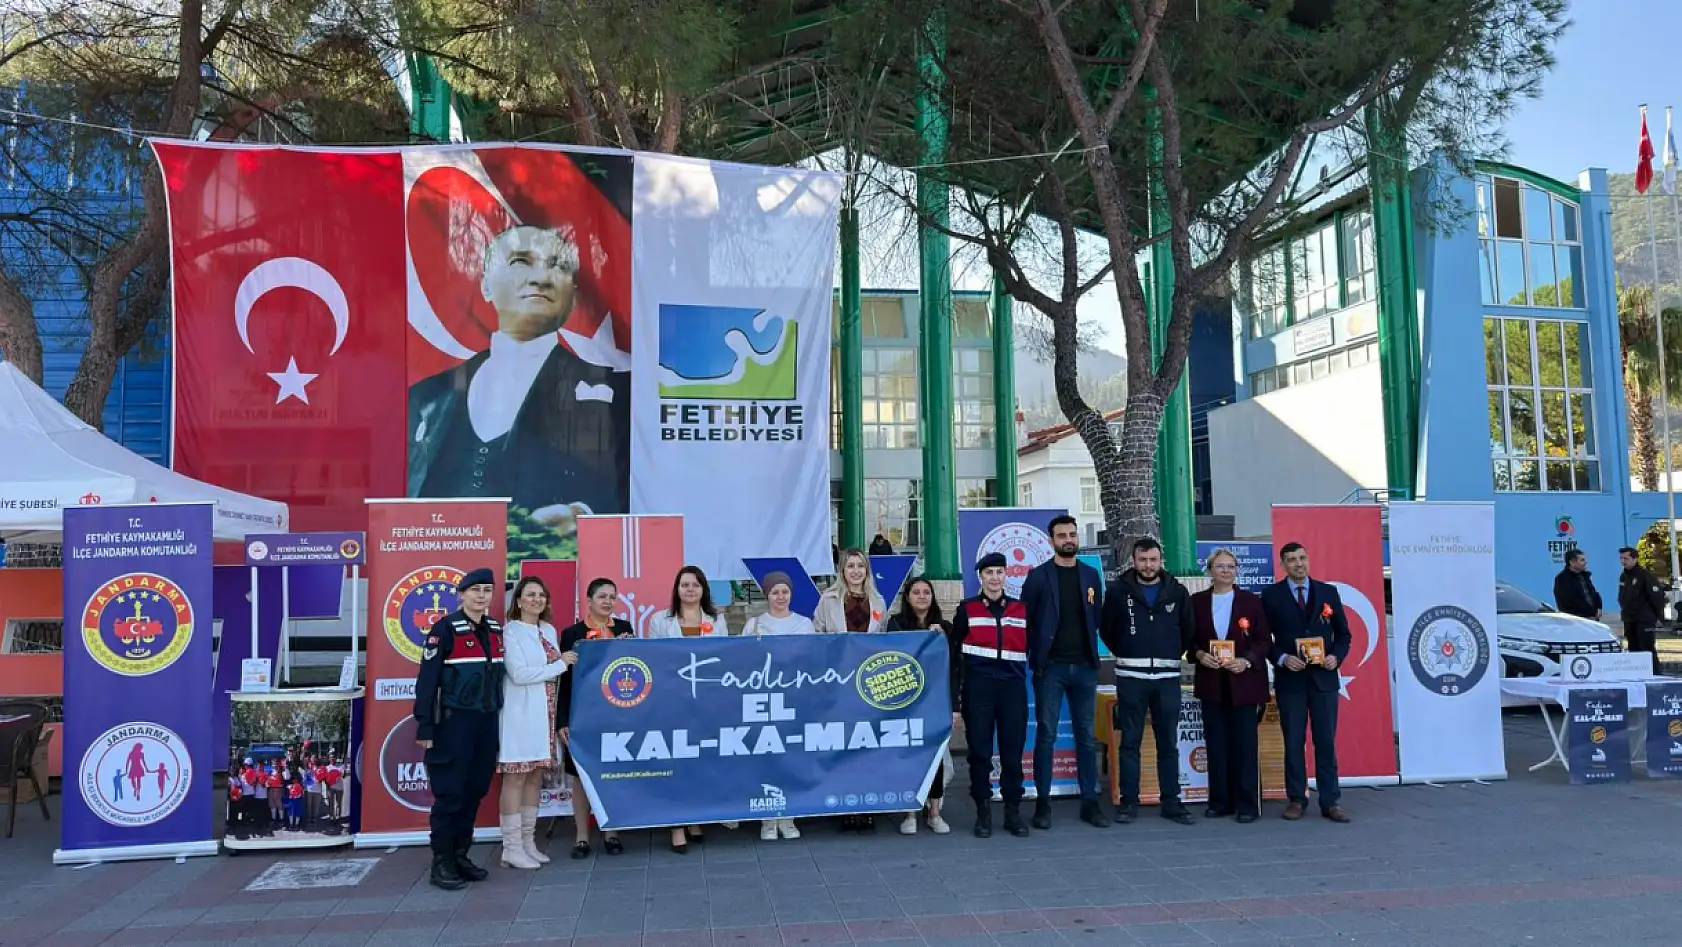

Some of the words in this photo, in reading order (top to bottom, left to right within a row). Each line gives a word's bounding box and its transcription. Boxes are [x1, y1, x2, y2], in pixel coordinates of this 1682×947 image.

[660, 402, 803, 425] FETHİYE
[661, 425, 803, 441] BELEDİYESİ
[19, 496, 58, 511] ŞUBESİ
[128, 518, 143, 528] T.C.
[431, 513, 446, 524] T.C.
[85, 531, 120, 544] FETHİYE
[122, 528, 185, 542] KAYMAKAMLIĞI
[392, 526, 424, 538] FETHİYE
[425, 524, 483, 537] KAYMAKAMLIĞI
[73, 546, 91, 560] İLÇE
[92, 546, 139, 558] JANDARMA
[140, 543, 197, 556] KOMUTANLIĞI
[380, 539, 397, 552] İLÇE
[398, 539, 441, 551] JANDARMA
[442, 537, 495, 551] KOMUTANLIĞI
[1548, 537, 1577, 552] FETHİY
[391, 570, 463, 608] JANDAR
[89, 577, 187, 618] JANDARMA
[742, 692, 795, 723] EL
[107, 726, 170, 748] JANDARMA
[601, 718, 924, 762] KAL-KA-MAZ!
[397, 761, 428, 781] KA
